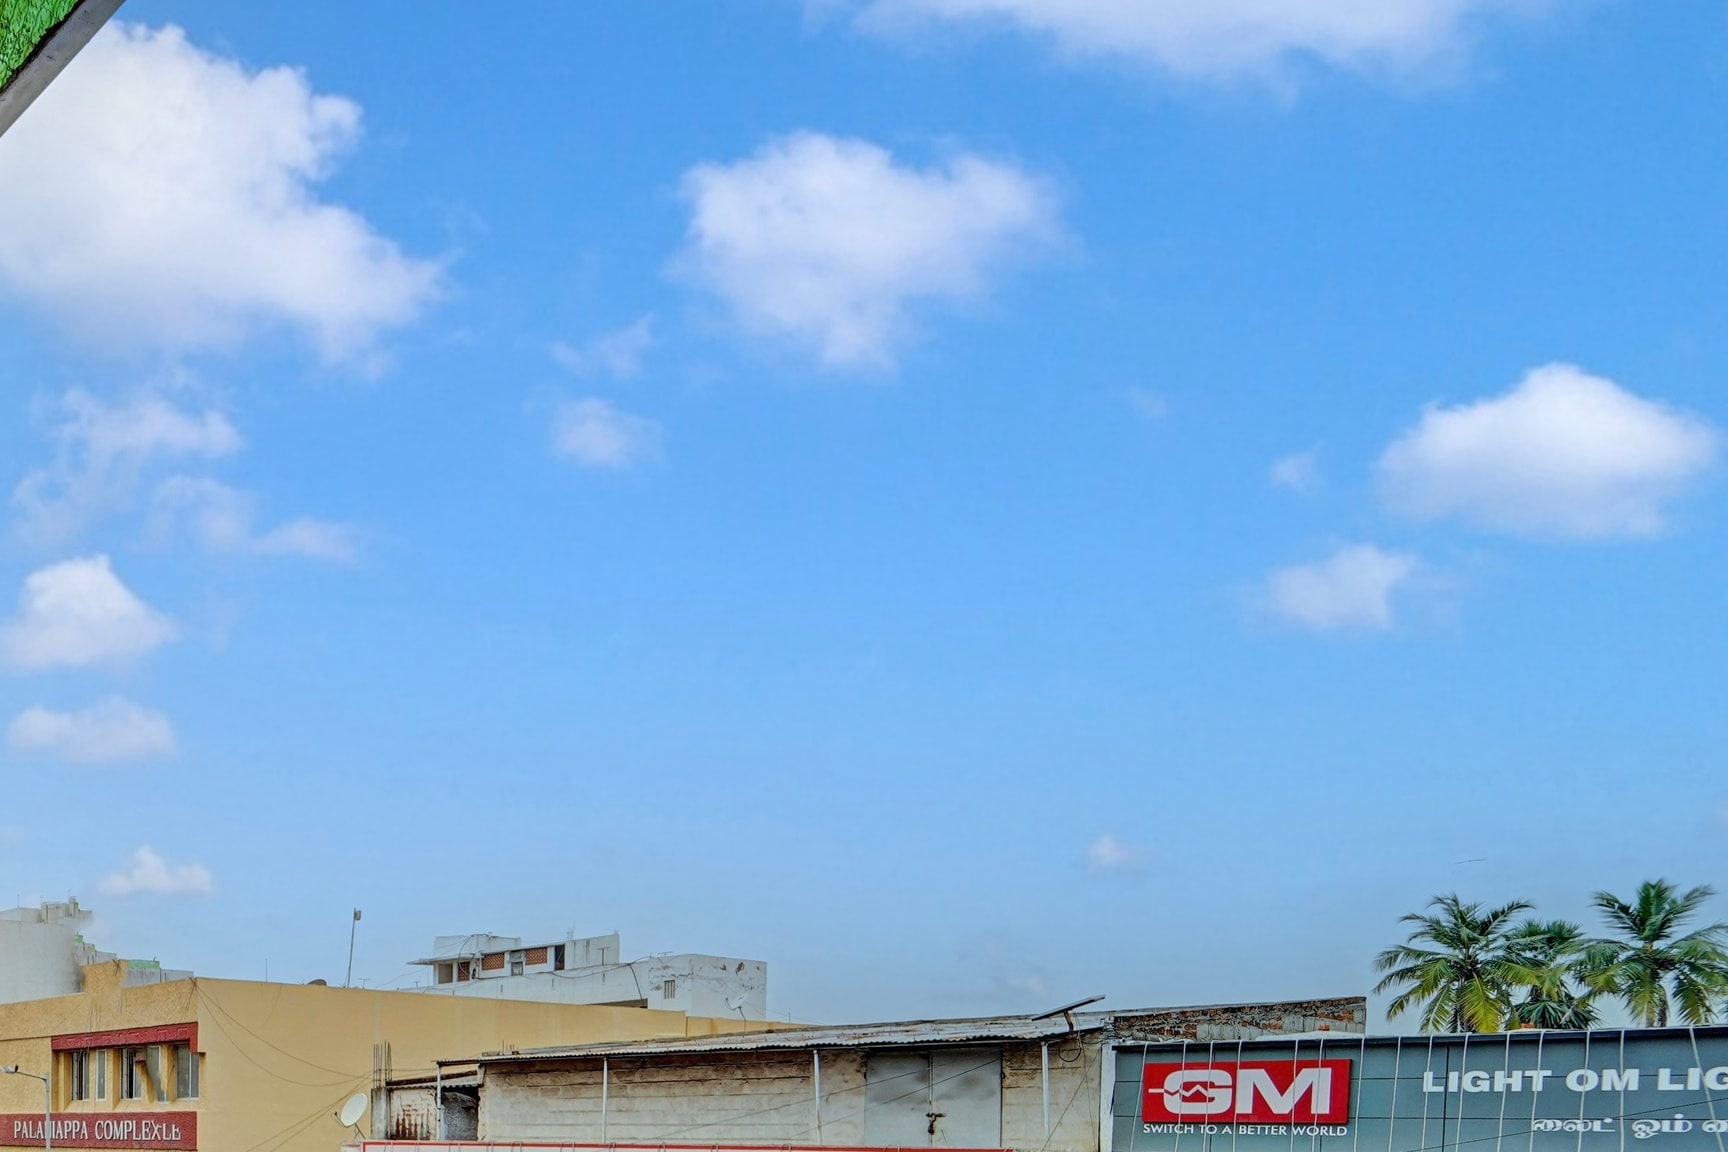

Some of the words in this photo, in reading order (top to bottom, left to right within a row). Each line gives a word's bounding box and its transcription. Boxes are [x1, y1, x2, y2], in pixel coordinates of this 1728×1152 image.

[1158, 1067, 1332, 1114] GM
[1423, 1070, 1552, 1093] LIGHT
[1566, 1068, 1640, 1092] OM
[14, 1120, 88, 1140] PALAIAPPA
[1143, 1123, 1194, 1134] SWITCH
[1199, 1124, 1217, 1134] TO
[1222, 1125, 1232, 1135] A
[1239, 1125, 1287, 1136] BETTER
[1292, 1126, 1348, 1136] WORLD
